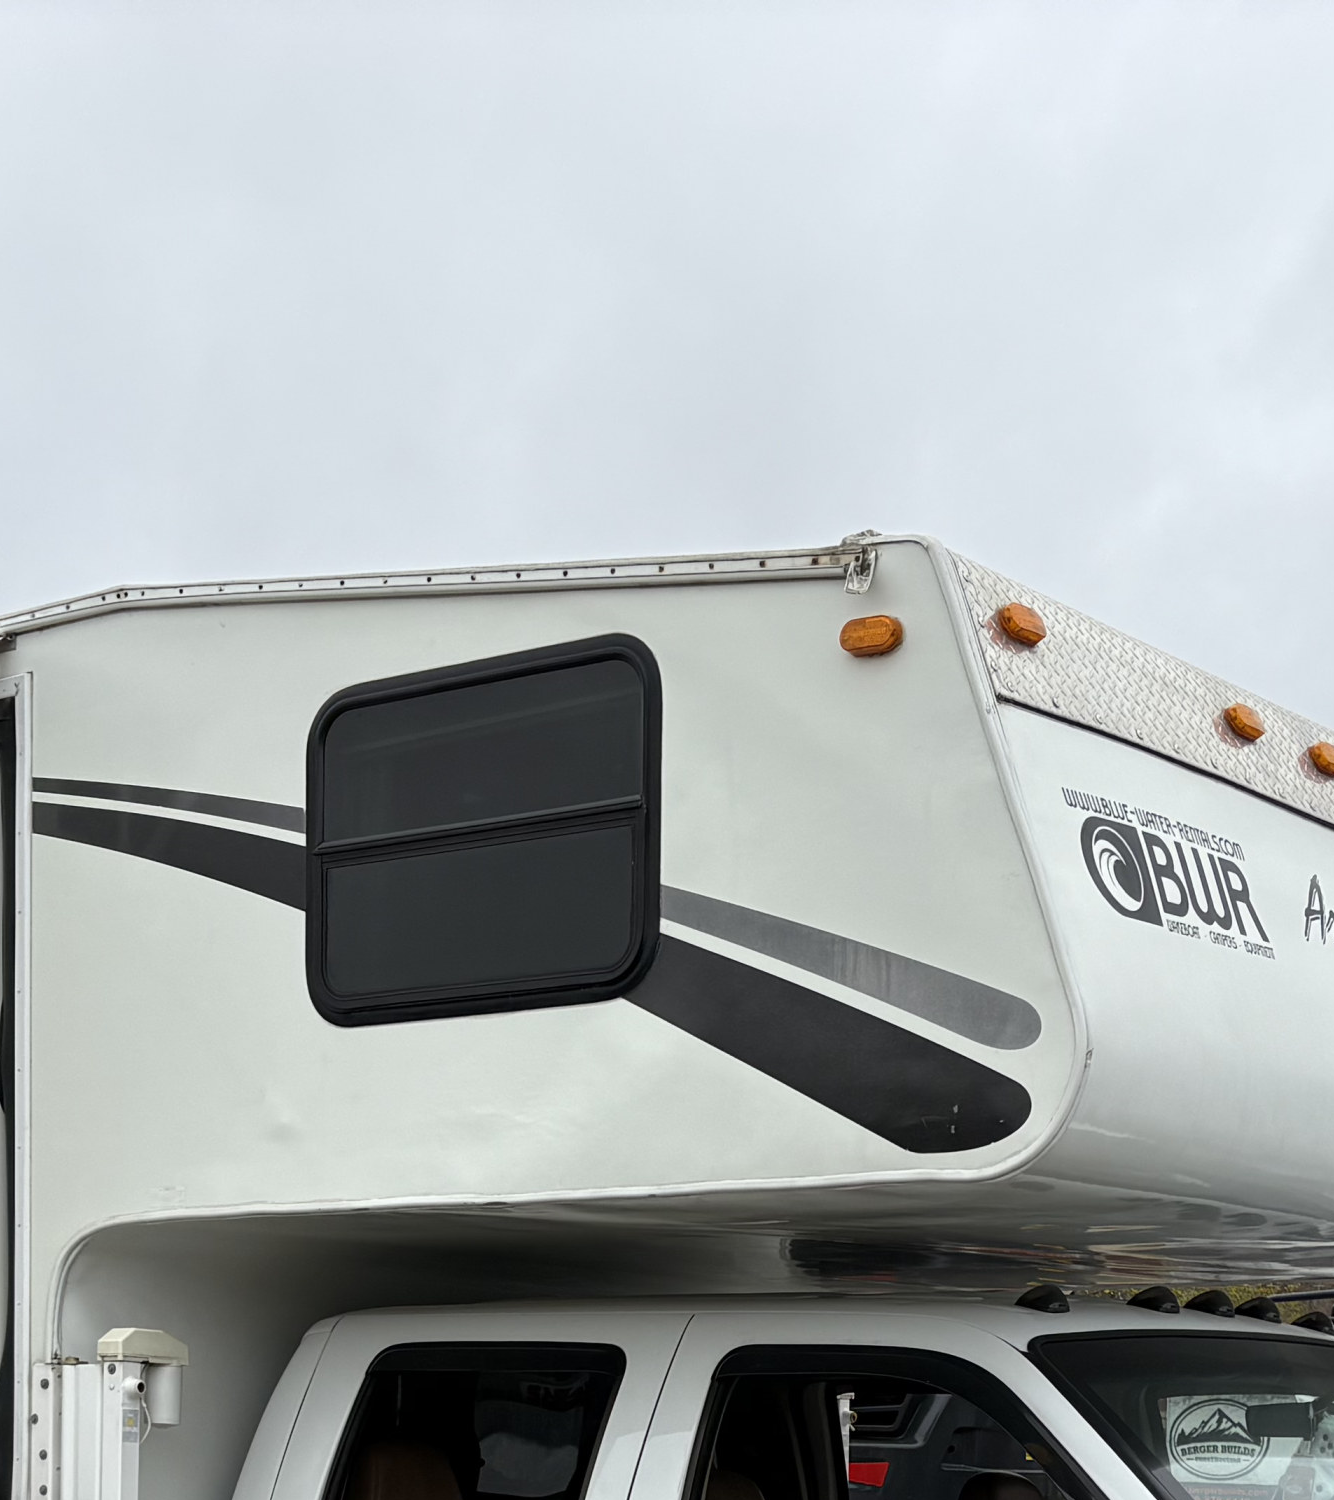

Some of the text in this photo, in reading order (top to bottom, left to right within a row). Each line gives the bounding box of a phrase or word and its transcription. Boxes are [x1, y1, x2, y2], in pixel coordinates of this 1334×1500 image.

[1142, 831, 1270, 942] BWR
[1180, 1445, 1256, 1458] BERGER BUILDS
